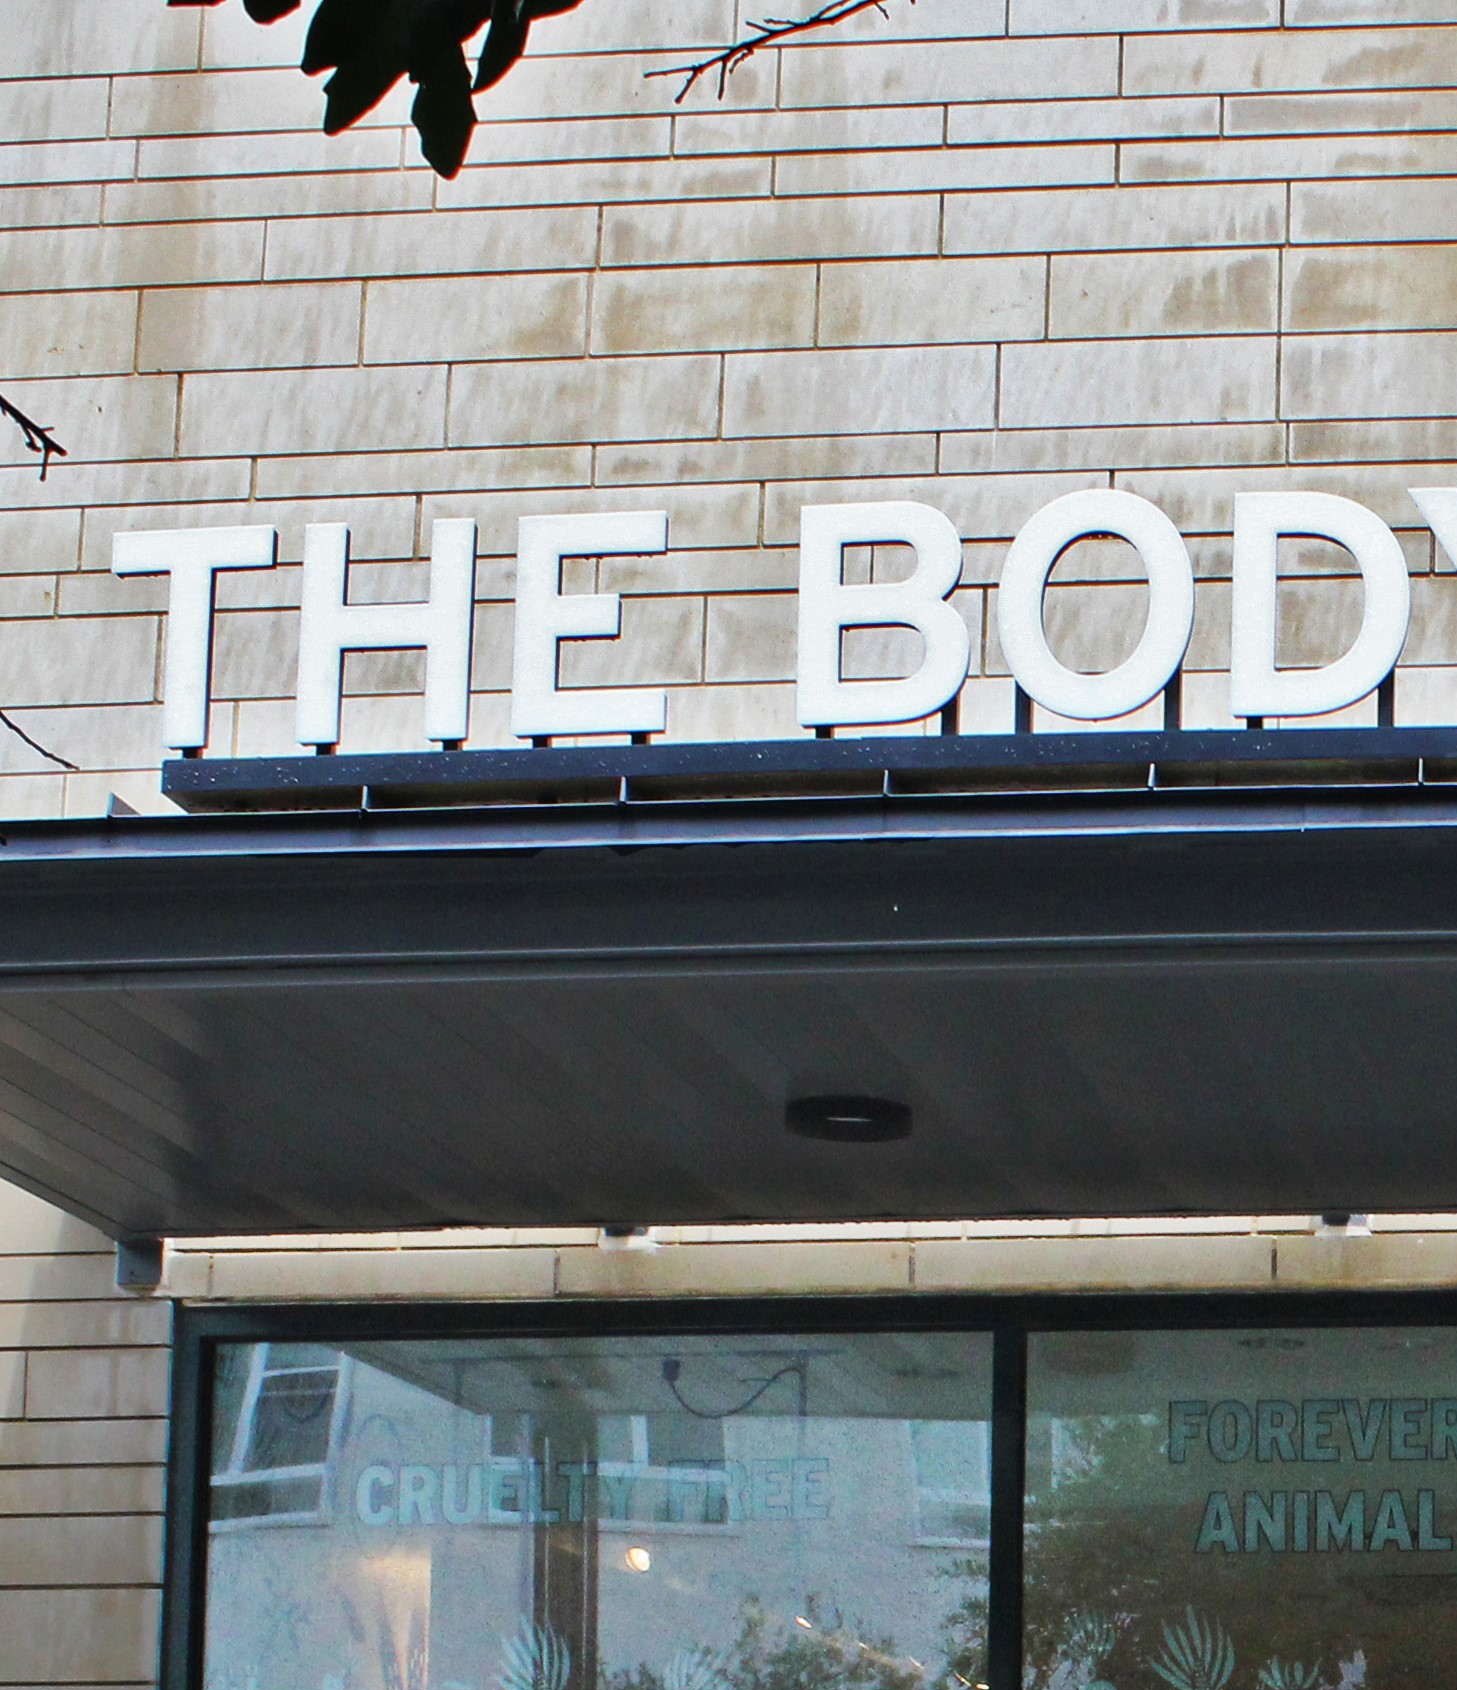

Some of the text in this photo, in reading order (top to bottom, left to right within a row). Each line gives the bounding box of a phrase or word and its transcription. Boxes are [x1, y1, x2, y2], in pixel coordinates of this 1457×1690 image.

[112, 510, 668, 750] THE
[355, 1457, 830, 1527] CRUELTY FREE
[1194, 1488, 1454, 1554] ANIMAL
